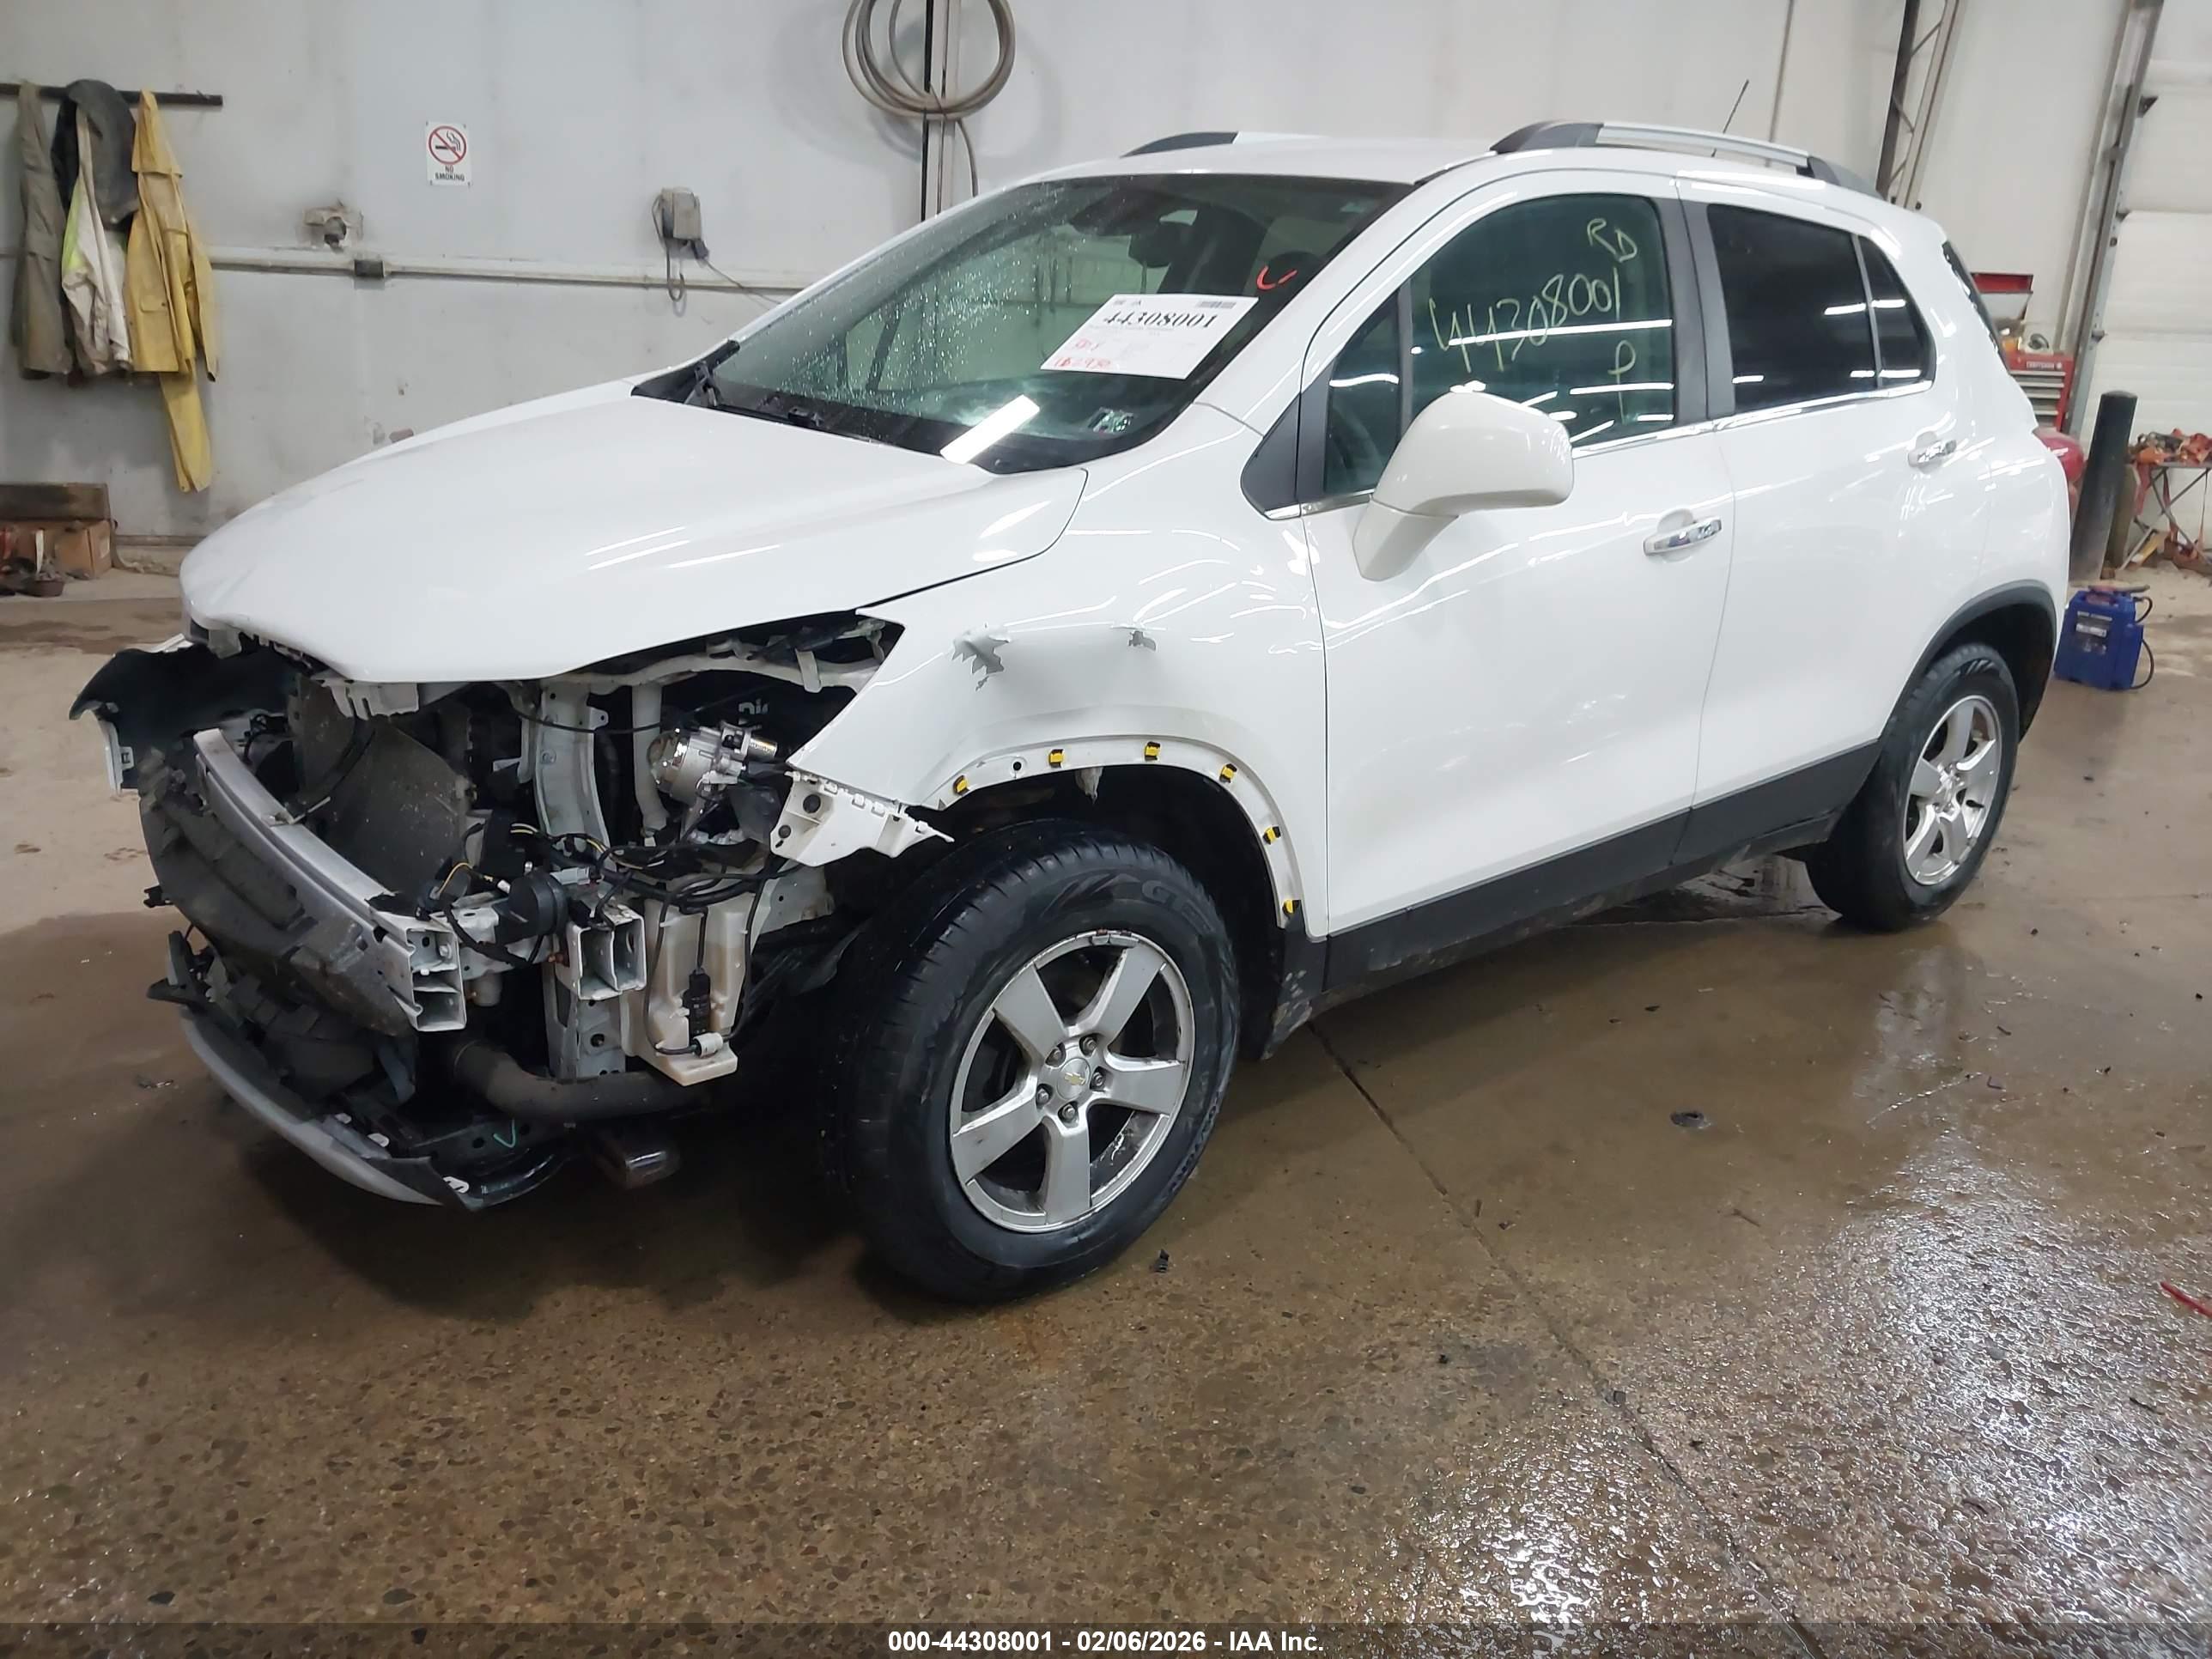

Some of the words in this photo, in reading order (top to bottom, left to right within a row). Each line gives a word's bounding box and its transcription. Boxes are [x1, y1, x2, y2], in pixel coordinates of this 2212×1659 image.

[445, 165, 454, 173] NO
[434, 173, 465, 181] SMOKING
[1103, 310, 1218, 329] 44308001
[1428, 266, 1620, 373] 44308001
